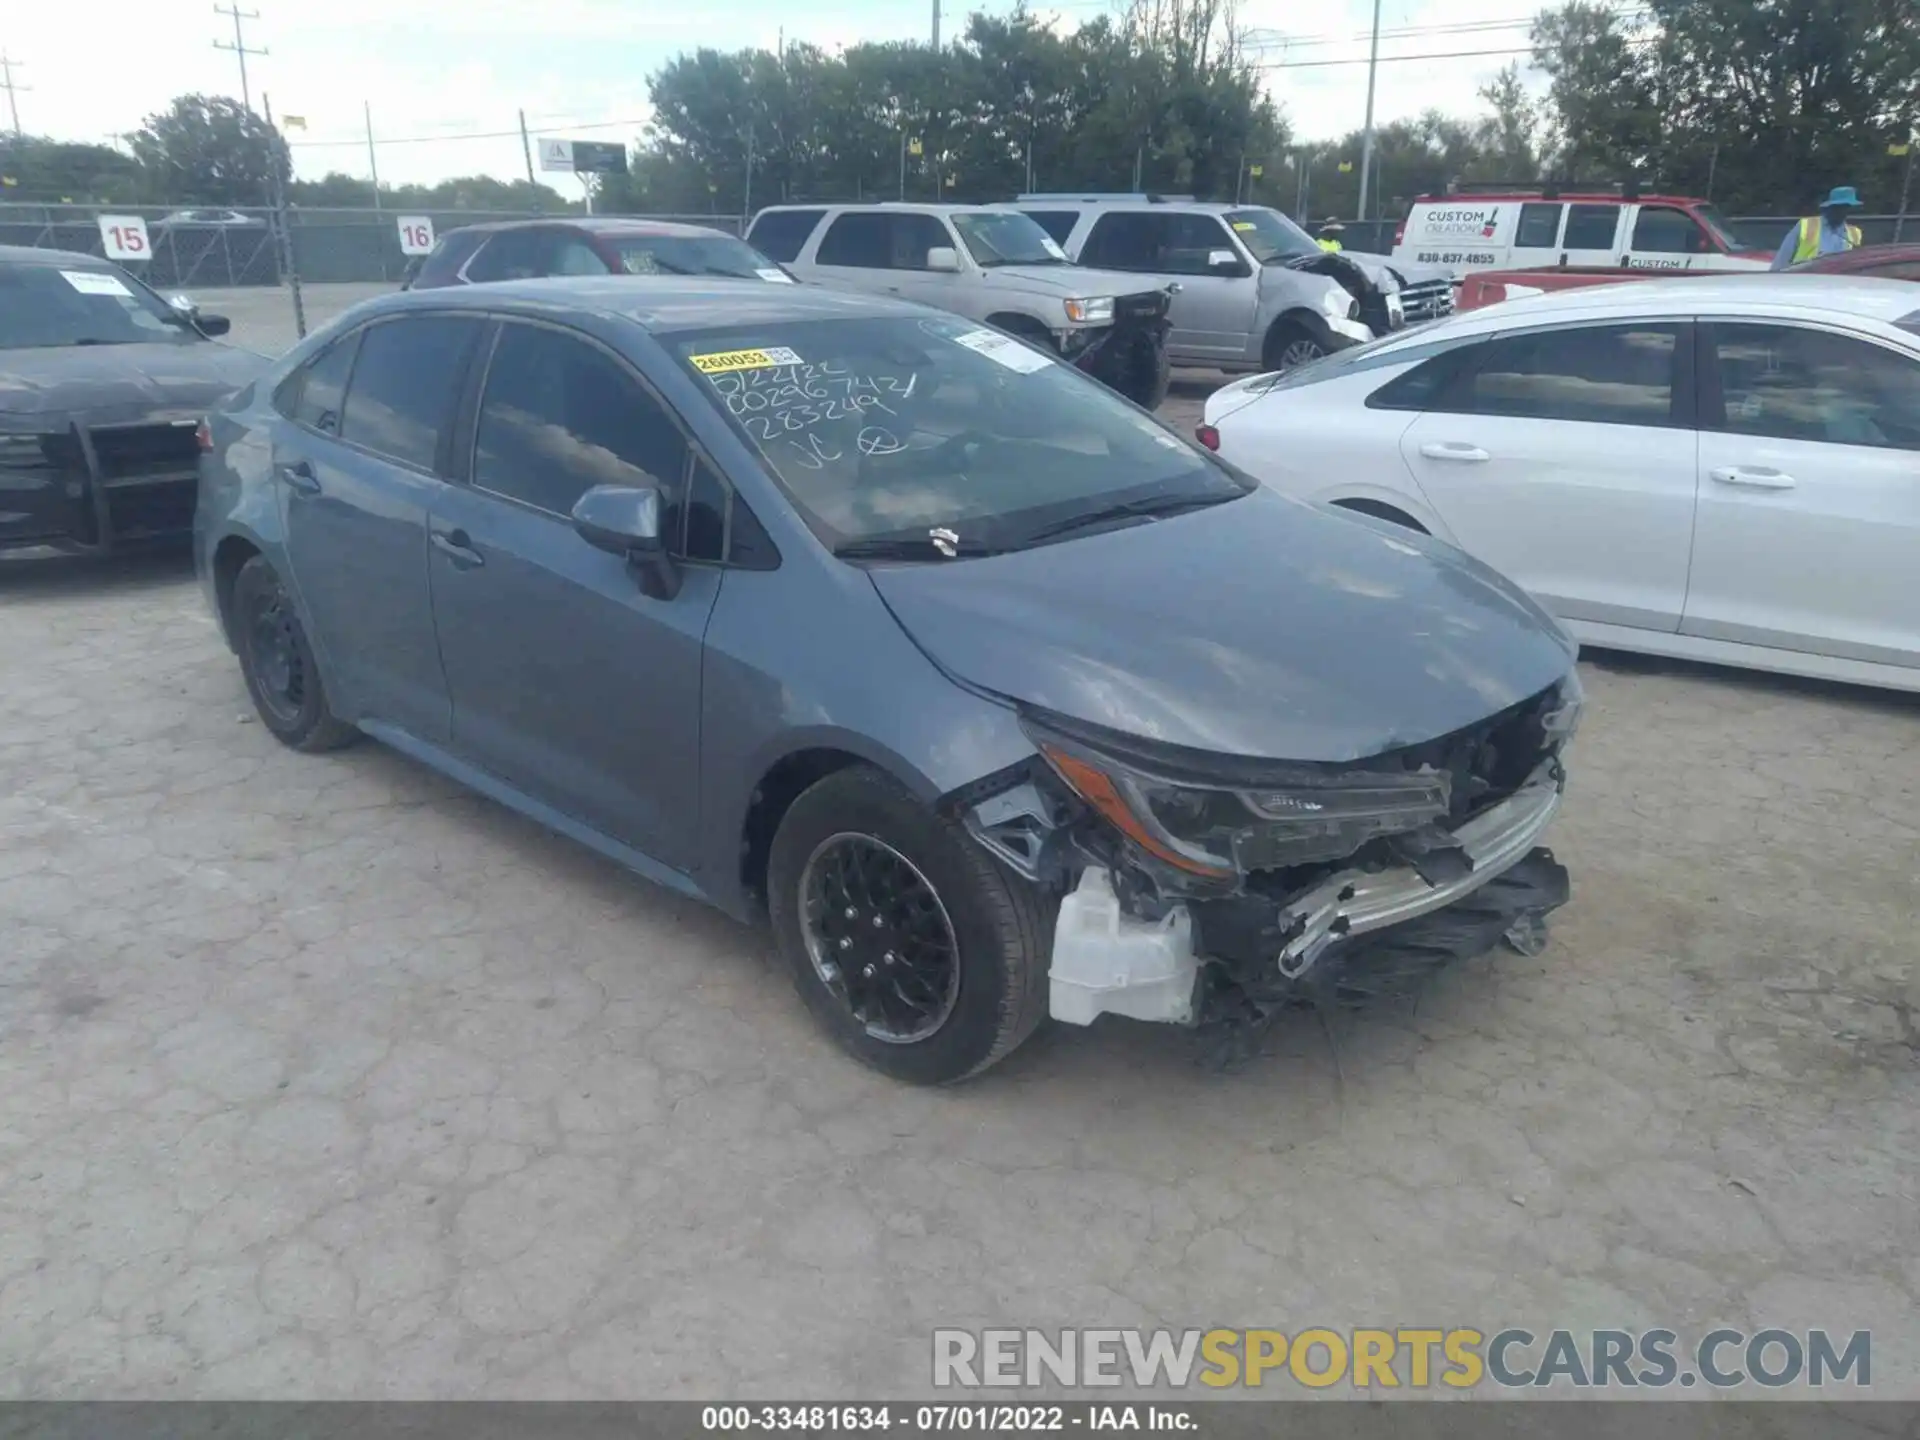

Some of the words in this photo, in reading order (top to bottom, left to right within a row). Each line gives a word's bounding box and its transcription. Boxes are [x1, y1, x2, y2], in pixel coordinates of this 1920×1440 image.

[1427, 211, 1484, 222] CUSTOM
[109, 226, 143, 251] 15
[402, 225, 430, 247] 16
[1631, 259, 1680, 269] CUSTOM
[696, 352, 769, 369] 260053
